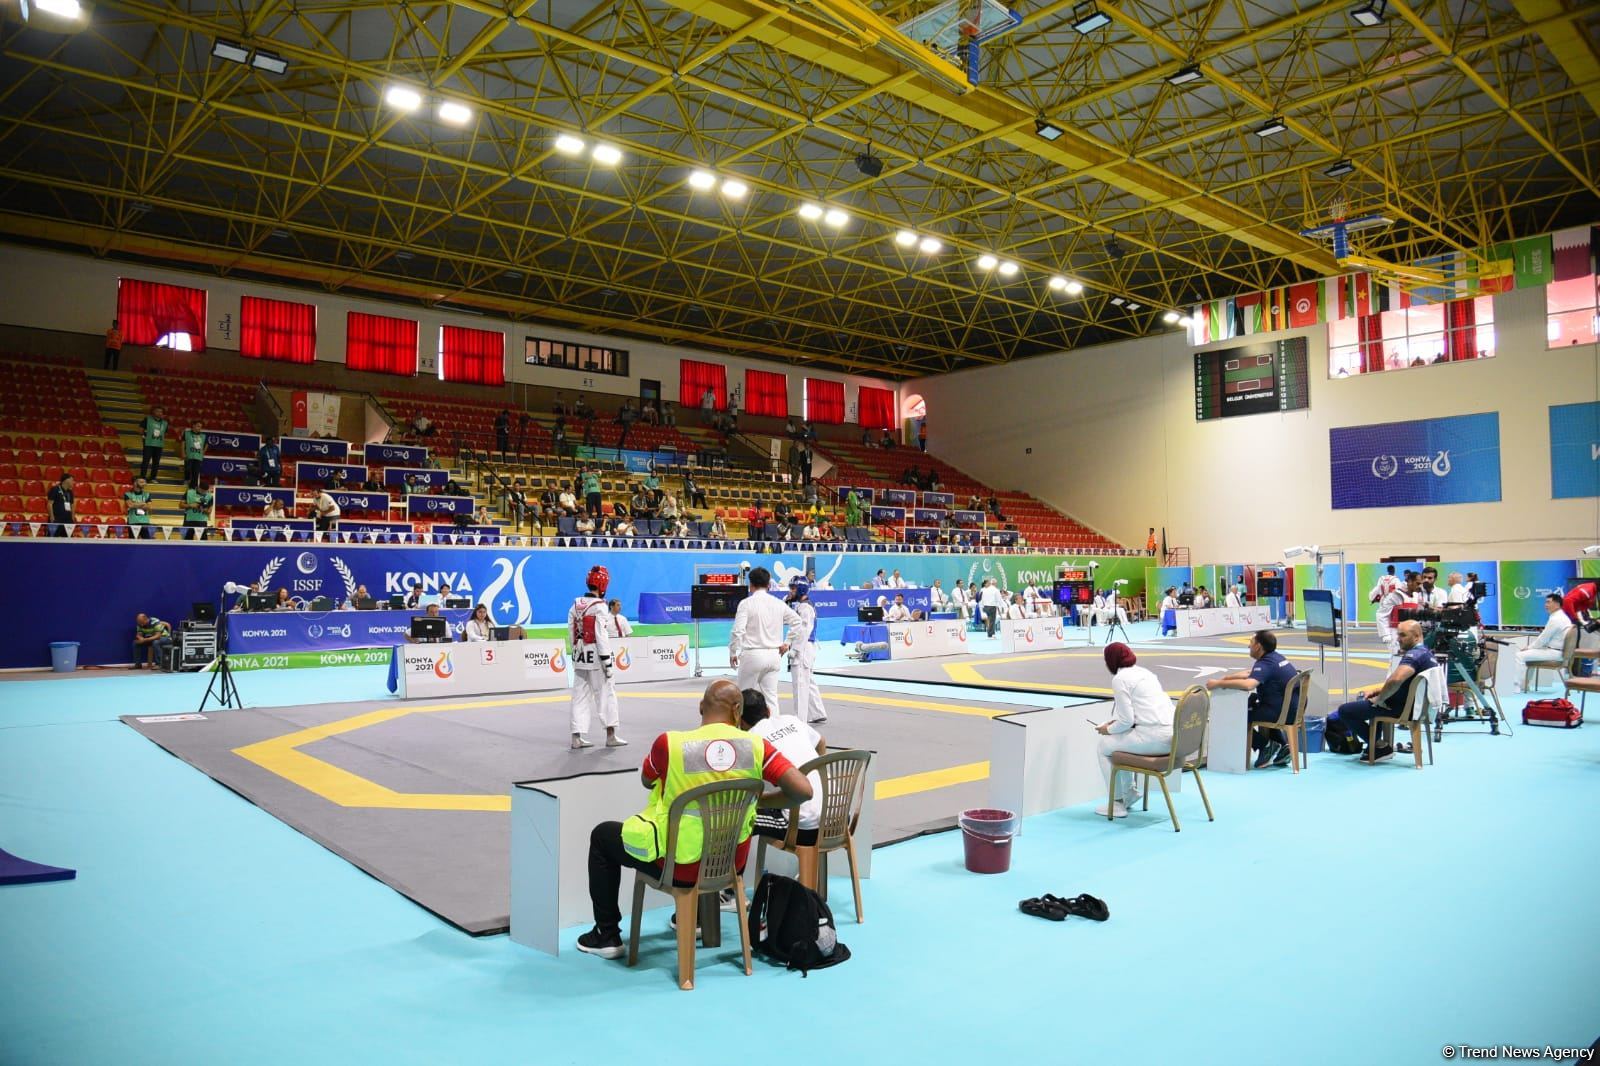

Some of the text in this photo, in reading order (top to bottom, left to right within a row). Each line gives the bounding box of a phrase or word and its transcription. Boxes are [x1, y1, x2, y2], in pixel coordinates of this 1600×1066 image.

[1404, 456, 1431, 464] KONYA
[386, 572, 472, 592] KONYA
[1018, 570, 1053, 584] KONYA
[294, 580, 322, 591] ISSF
[320, 652, 388, 664] KONYA 2021
[486, 650, 494, 661] 3
[226, 656, 289, 669] ONYA 2021
[767, 724, 798, 742] LESTINE
